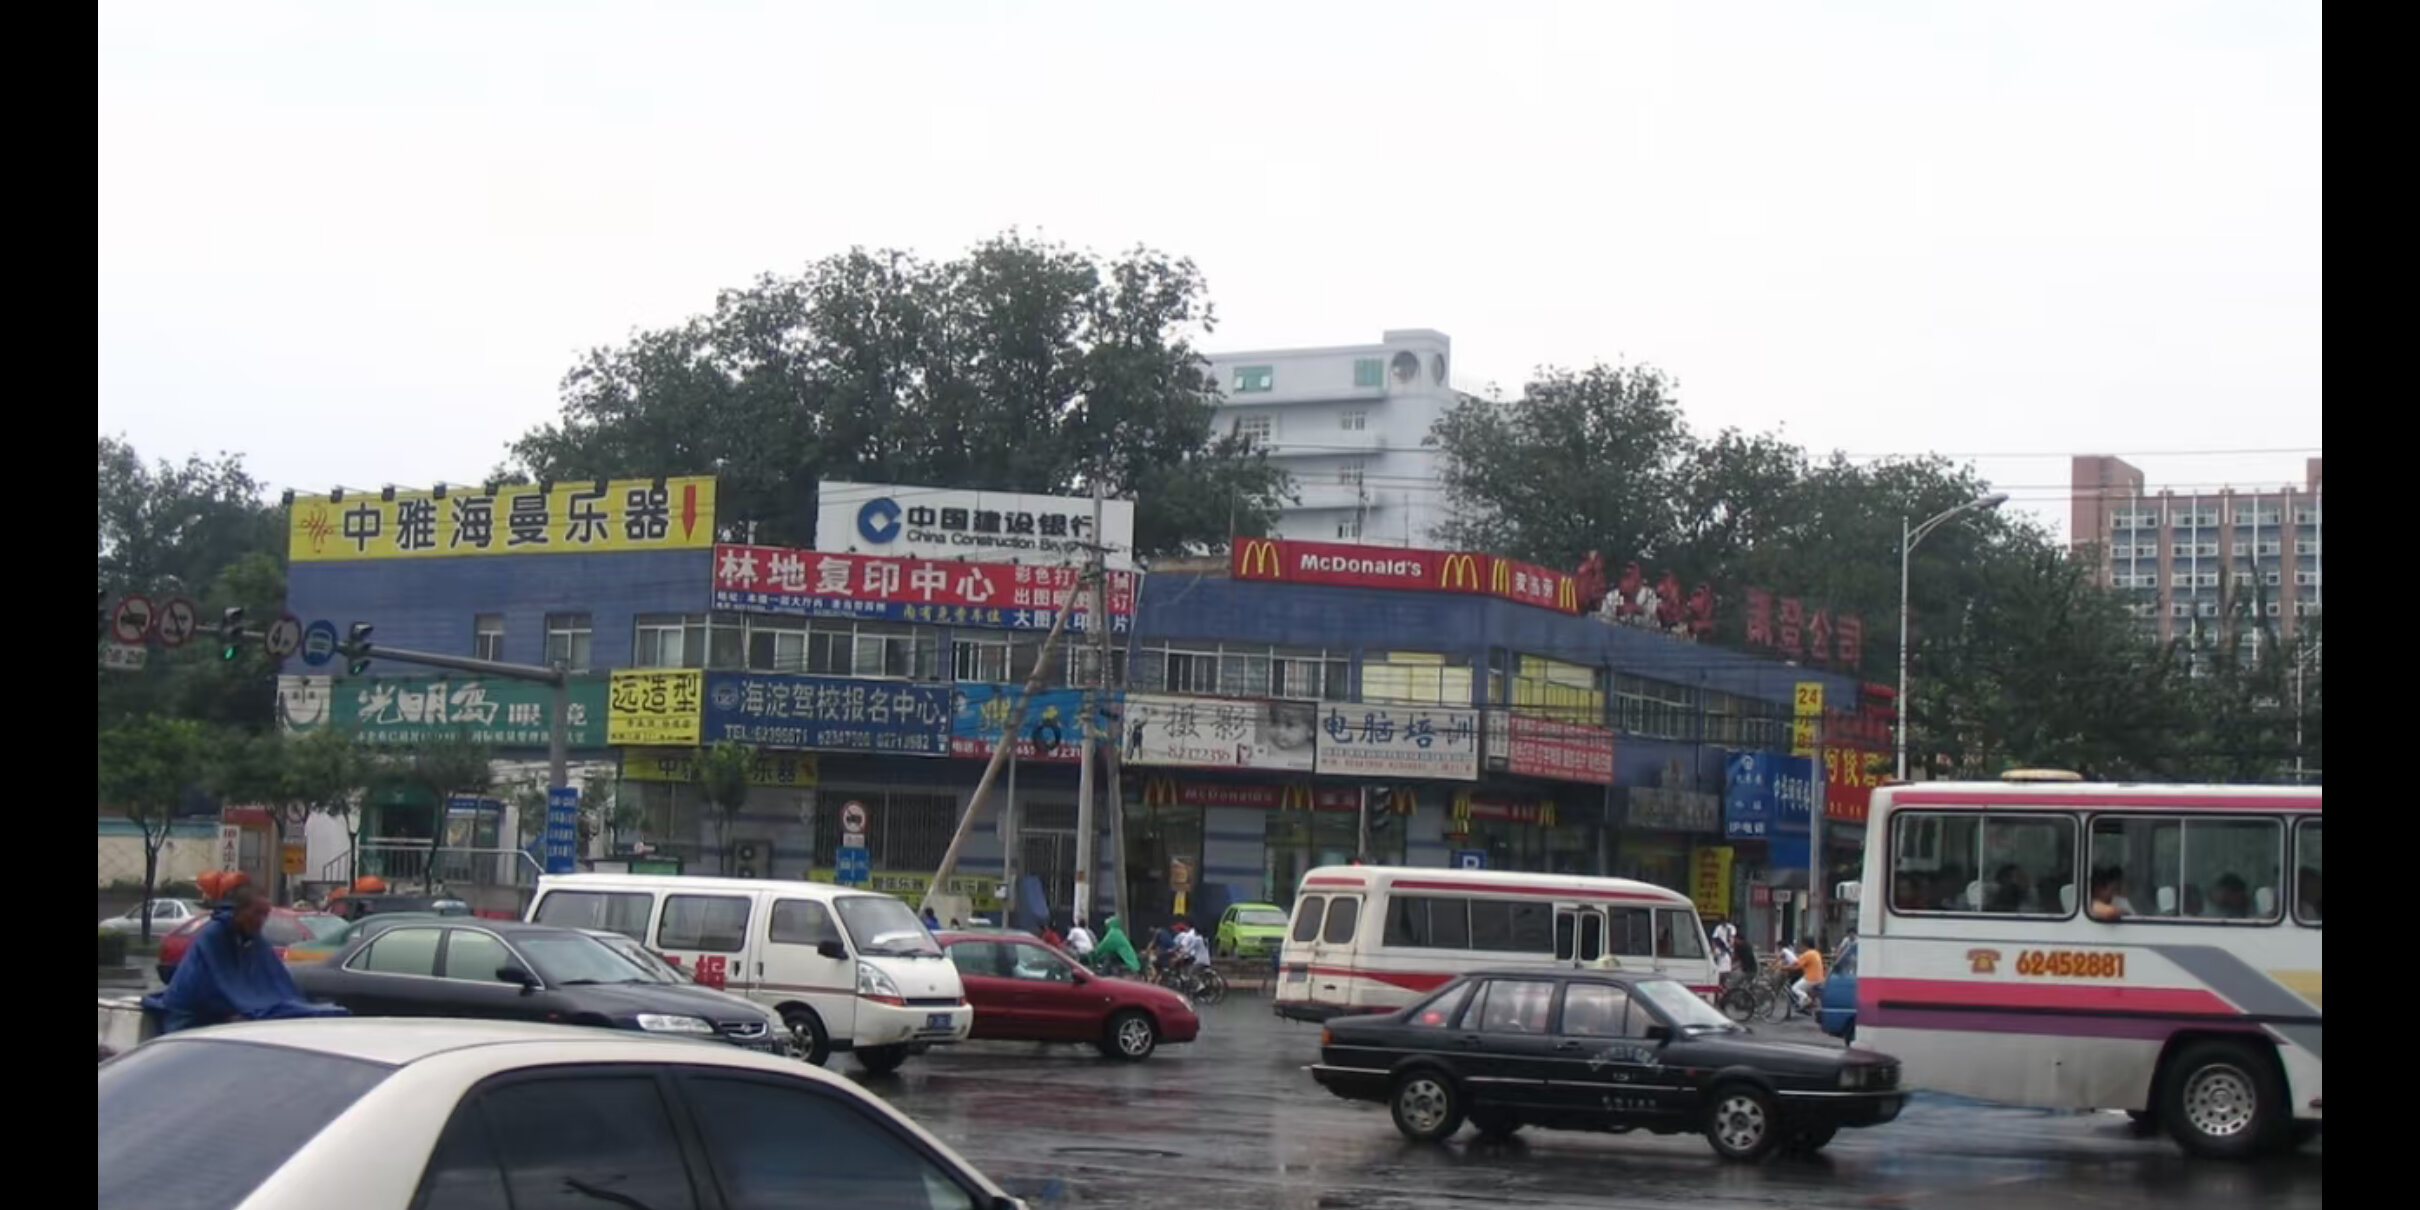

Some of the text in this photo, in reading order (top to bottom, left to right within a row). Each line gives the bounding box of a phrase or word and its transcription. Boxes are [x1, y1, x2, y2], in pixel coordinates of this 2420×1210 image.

[344, 490, 669, 552] 中雅海曼乐器
[908, 505, 1092, 538] 中国建设银行
[908, 529, 946, 544] China
[950, 533, 1035, 550] Construction
[719, 550, 995, 602] 林地复印中心
[1300, 554, 1422, 577] McDonald's
[1515, 571, 1554, 598] 麦当劳
[740, 680, 940, 725] 海淀驾校报名中心
[1799, 688, 1818, 704] 24
[1164, 703, 1247, 740] 摄影
[1323, 708, 1473, 752] 电脑培训
[2016, 949, 2126, 979] 62452881
